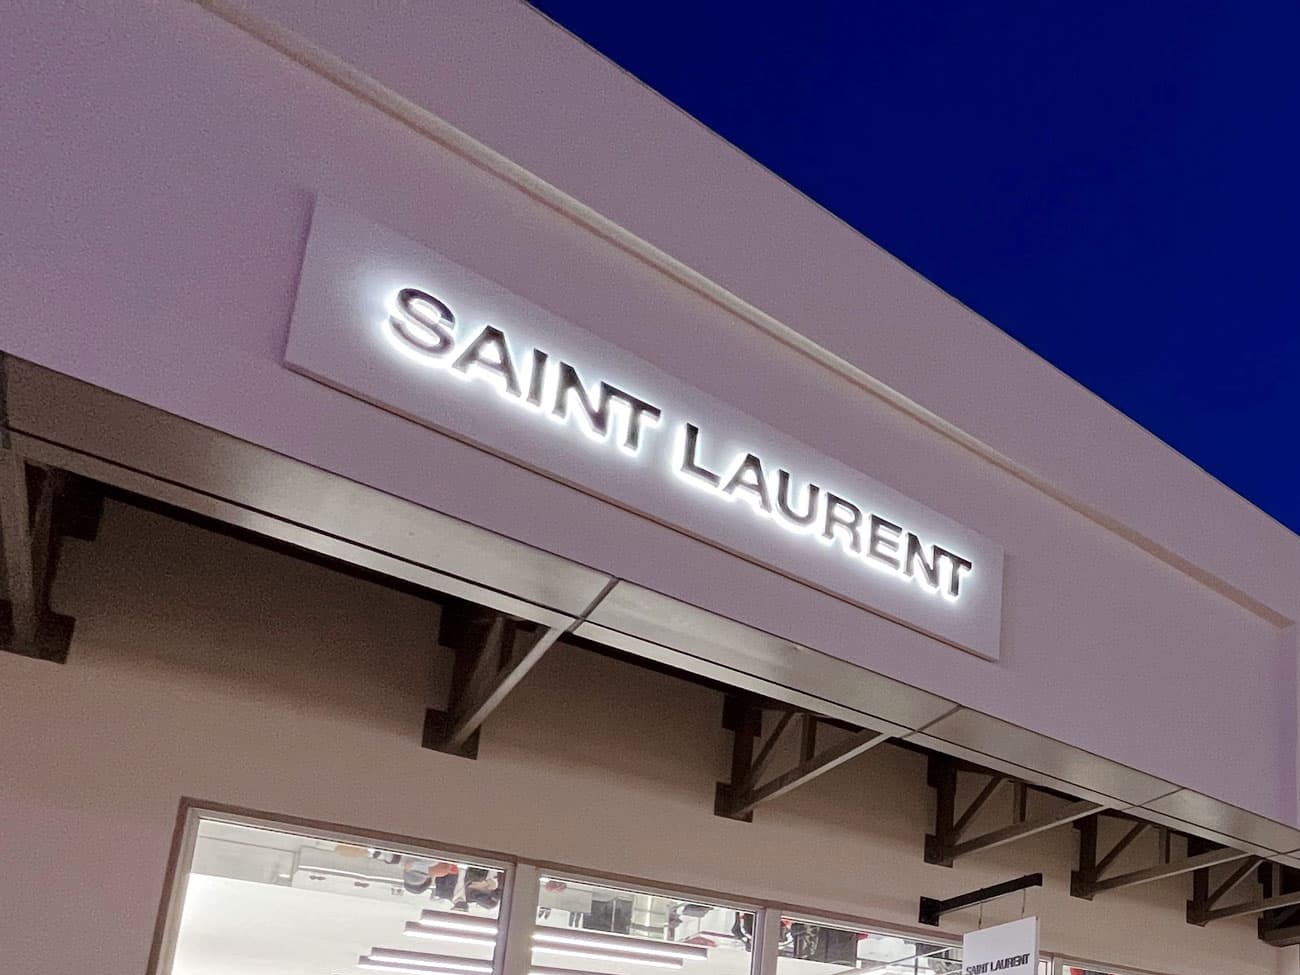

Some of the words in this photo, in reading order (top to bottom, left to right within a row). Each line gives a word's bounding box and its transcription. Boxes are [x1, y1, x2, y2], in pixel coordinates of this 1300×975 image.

[389, 287, 662, 450] SAINT
[681, 422, 972, 597] LAURENT
[965, 962, 989, 975] SAINT
[991, 954, 1030, 972] LAURENT
